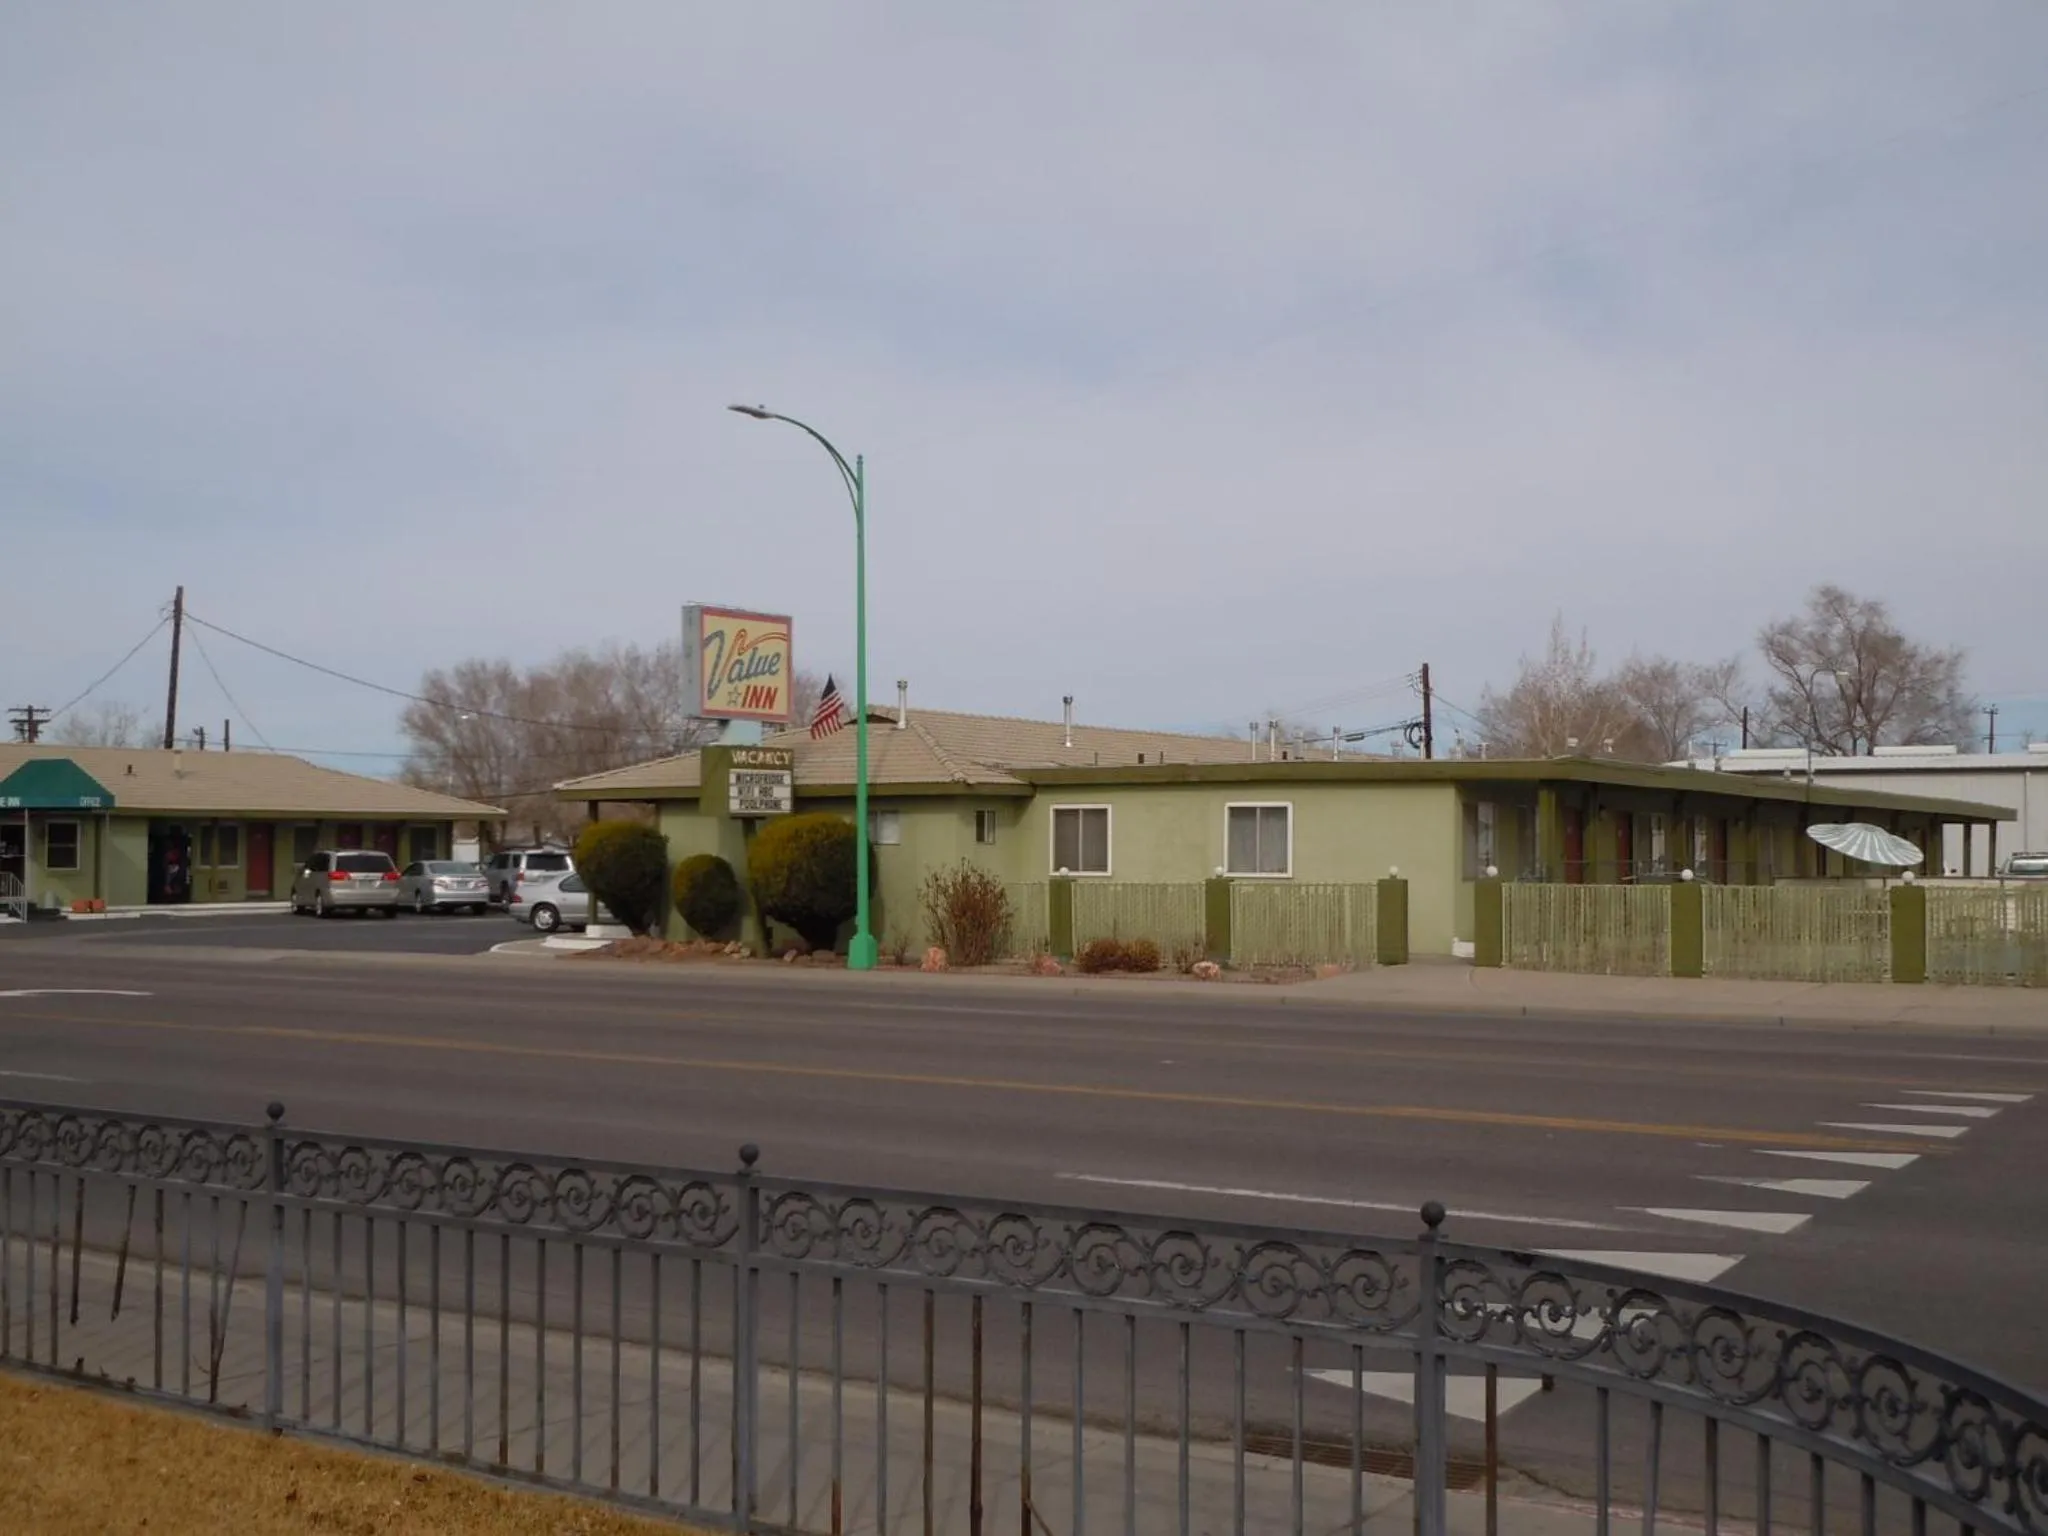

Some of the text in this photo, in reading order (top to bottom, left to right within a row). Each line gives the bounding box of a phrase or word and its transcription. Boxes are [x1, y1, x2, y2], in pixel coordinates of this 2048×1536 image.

[702, 629, 781, 700] Value
[742, 684, 778, 710] INN
[731, 750, 791, 764] VACANCY
